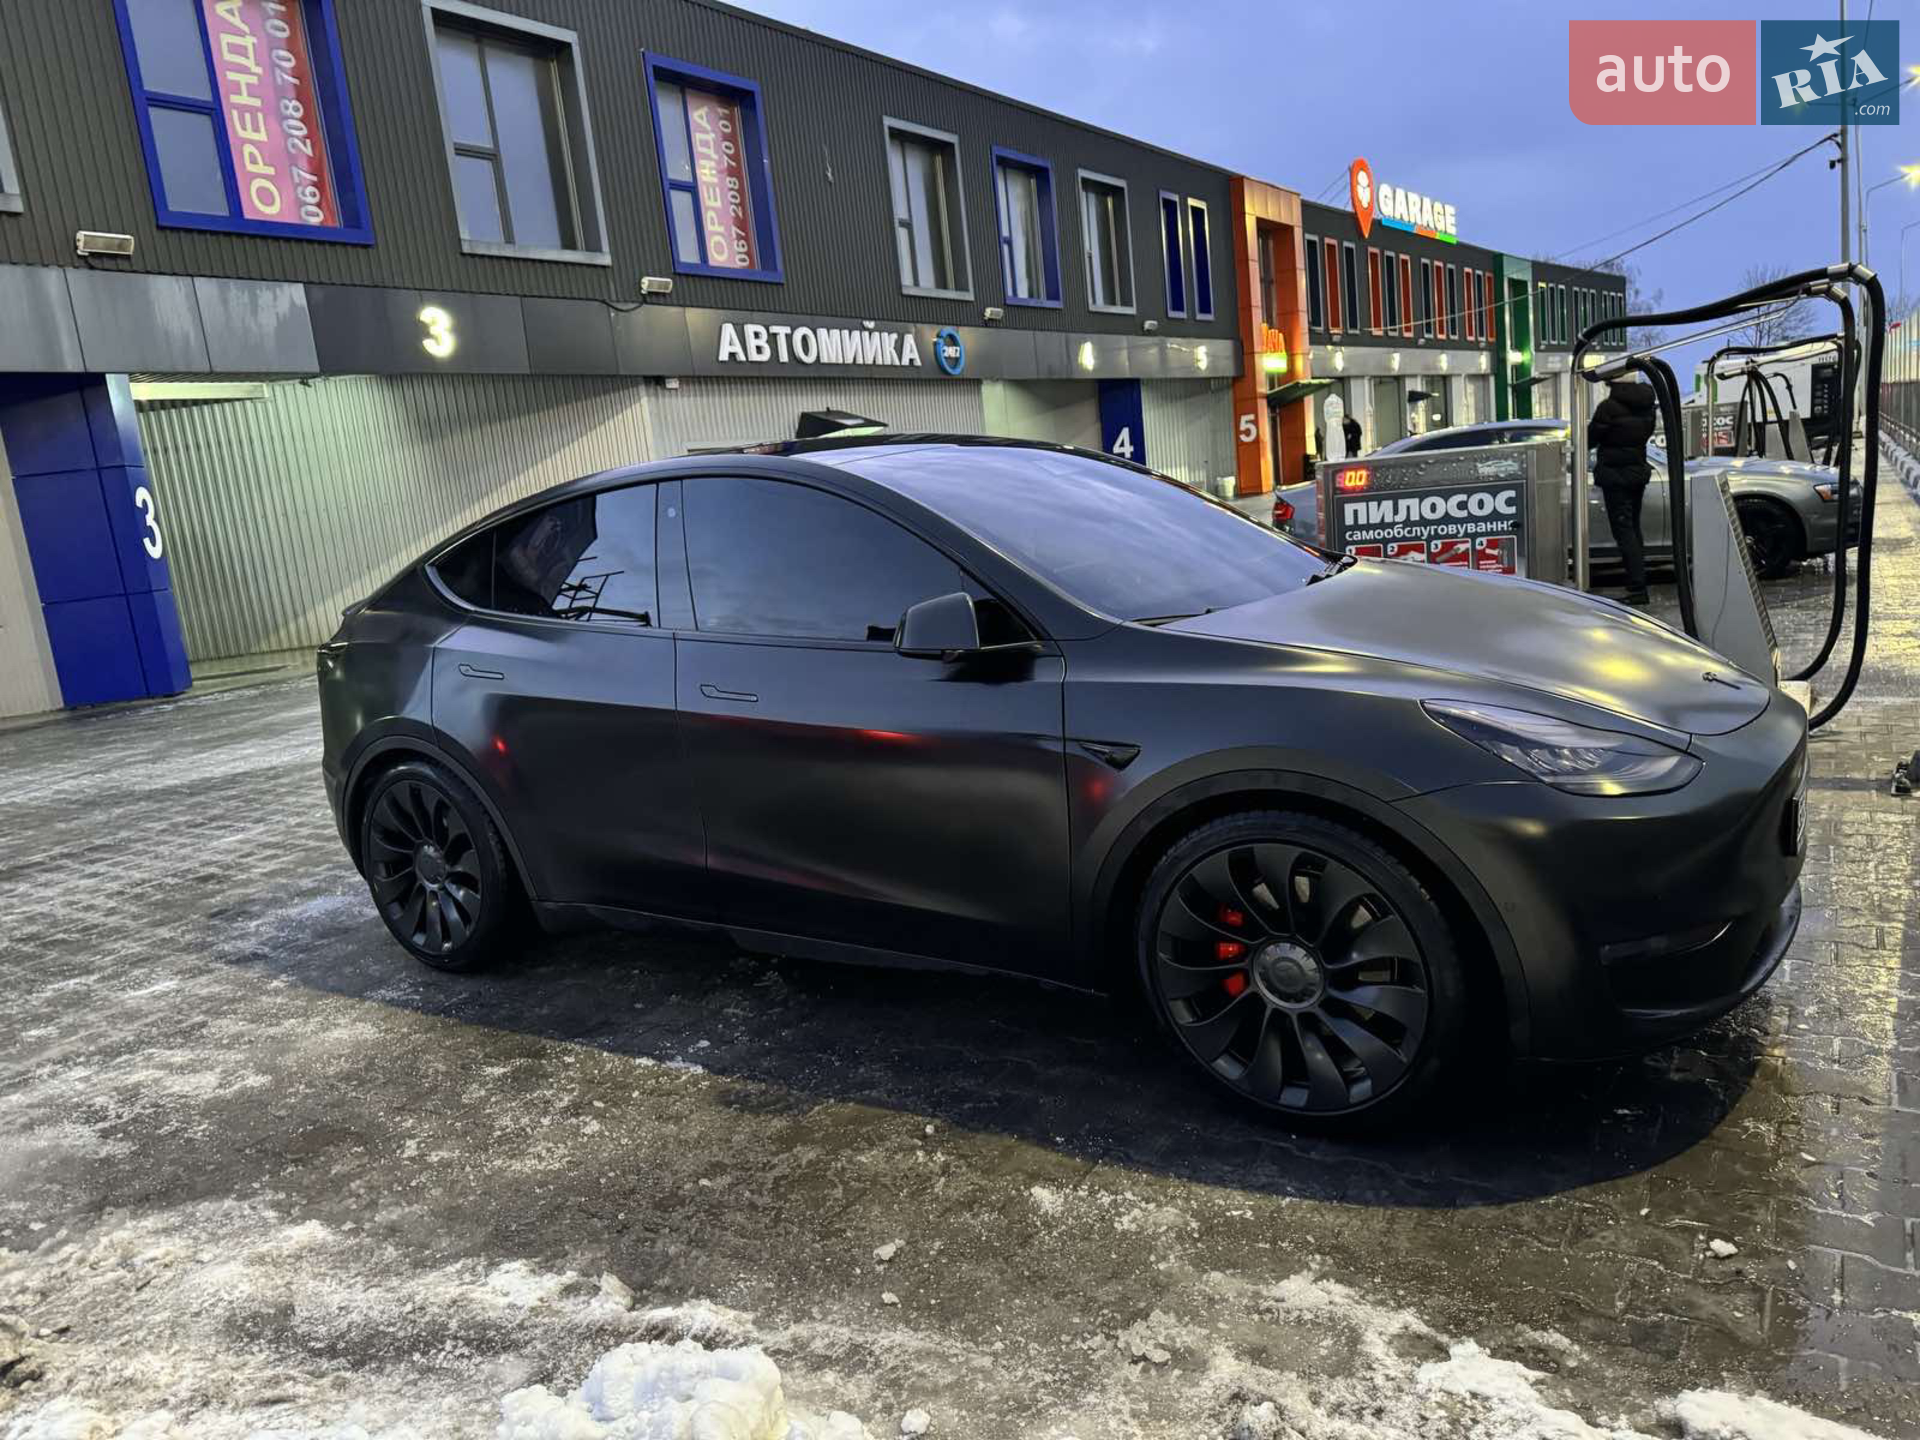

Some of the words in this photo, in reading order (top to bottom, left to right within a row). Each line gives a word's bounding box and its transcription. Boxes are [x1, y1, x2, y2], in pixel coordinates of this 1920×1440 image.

[261, 0, 290, 39] 01
[272, 49, 300, 85] 70
[214, 0, 281, 215] ОРЕНДА
[281, 99, 314, 157] 208
[718, 106, 733, 132] 01
[722, 141, 737, 168] 70
[291, 166, 325, 225] 067
[694, 104, 729, 262] ОРЕНДА
[726, 177, 744, 218] 208
[1378, 183, 1457, 235] GARAGE
[731, 227, 750, 267] 067
[419, 306, 455, 357] 3
[718, 320, 922, 366] АВТОМИЙКА
[1112, 427, 1134, 459] 4
[1239, 413, 1257, 442] 5
[135, 486, 163, 559] 3
[1344, 490, 1517, 526] ПИЛОСОС
